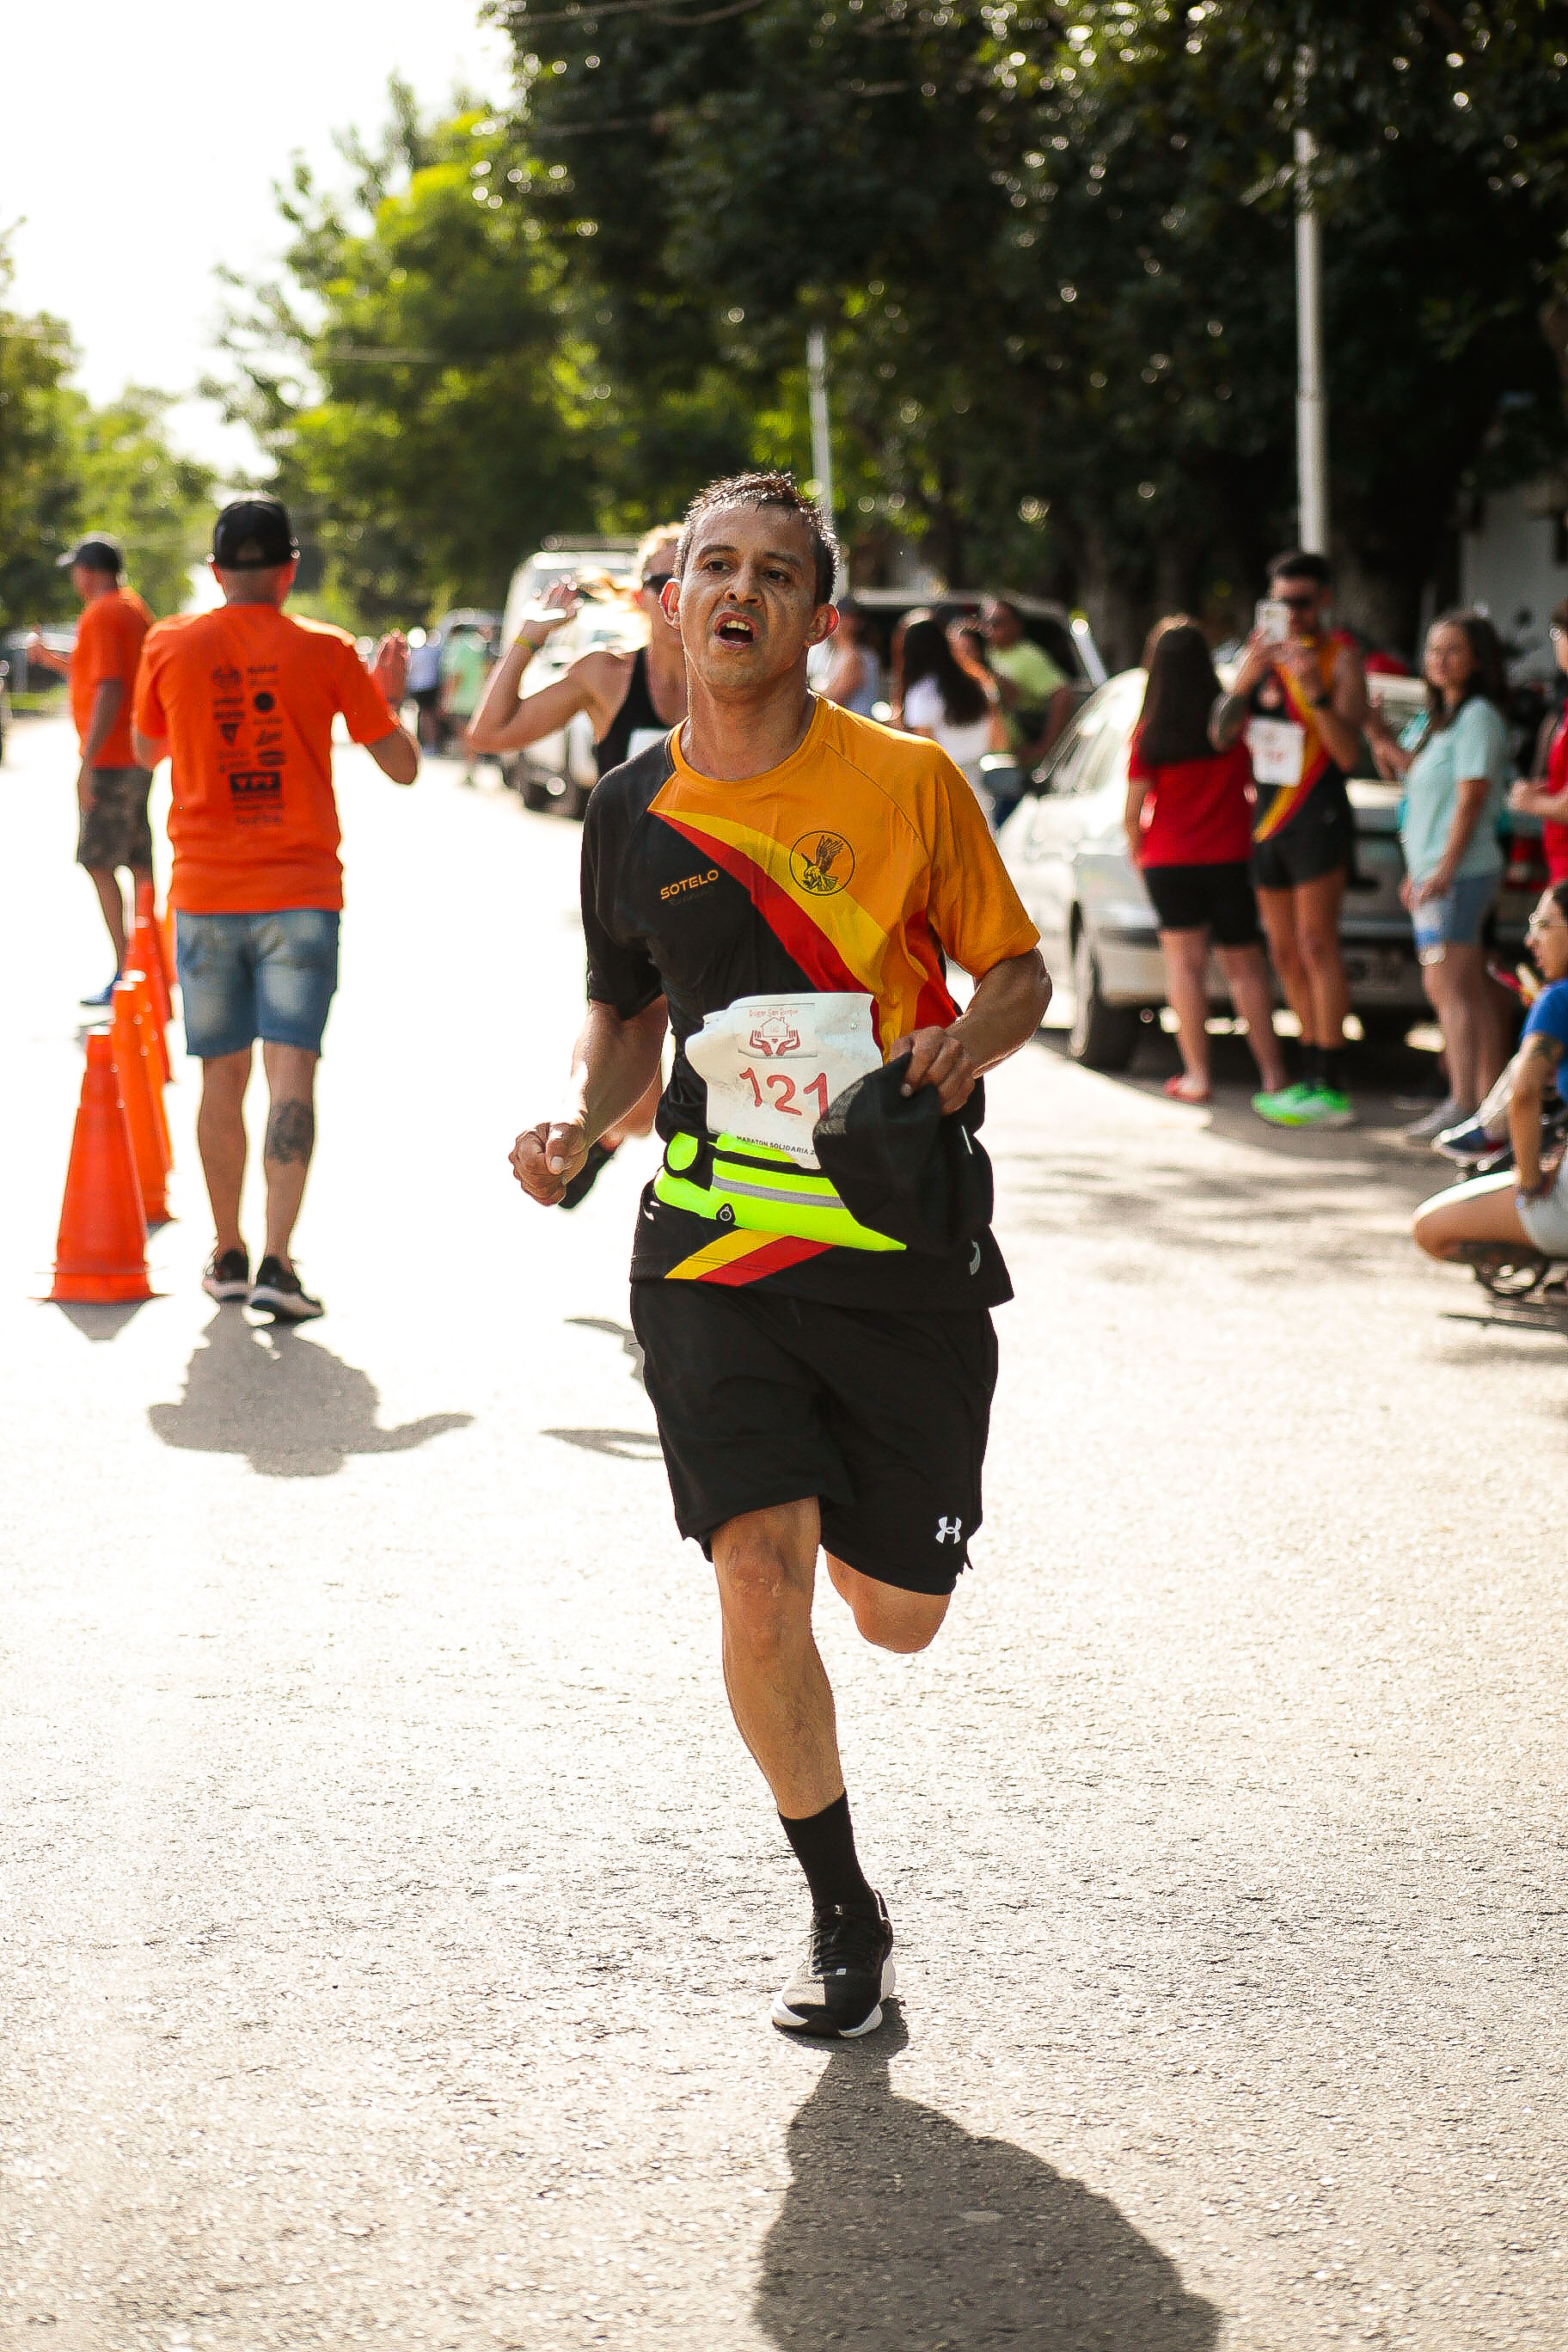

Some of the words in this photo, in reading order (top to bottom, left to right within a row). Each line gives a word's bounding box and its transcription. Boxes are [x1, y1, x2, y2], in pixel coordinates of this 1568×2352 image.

[660, 869, 719, 900] SOTELO
[739, 1067, 829, 1121] 121
[769, 1142, 809, 1155] SOLIDARIA
